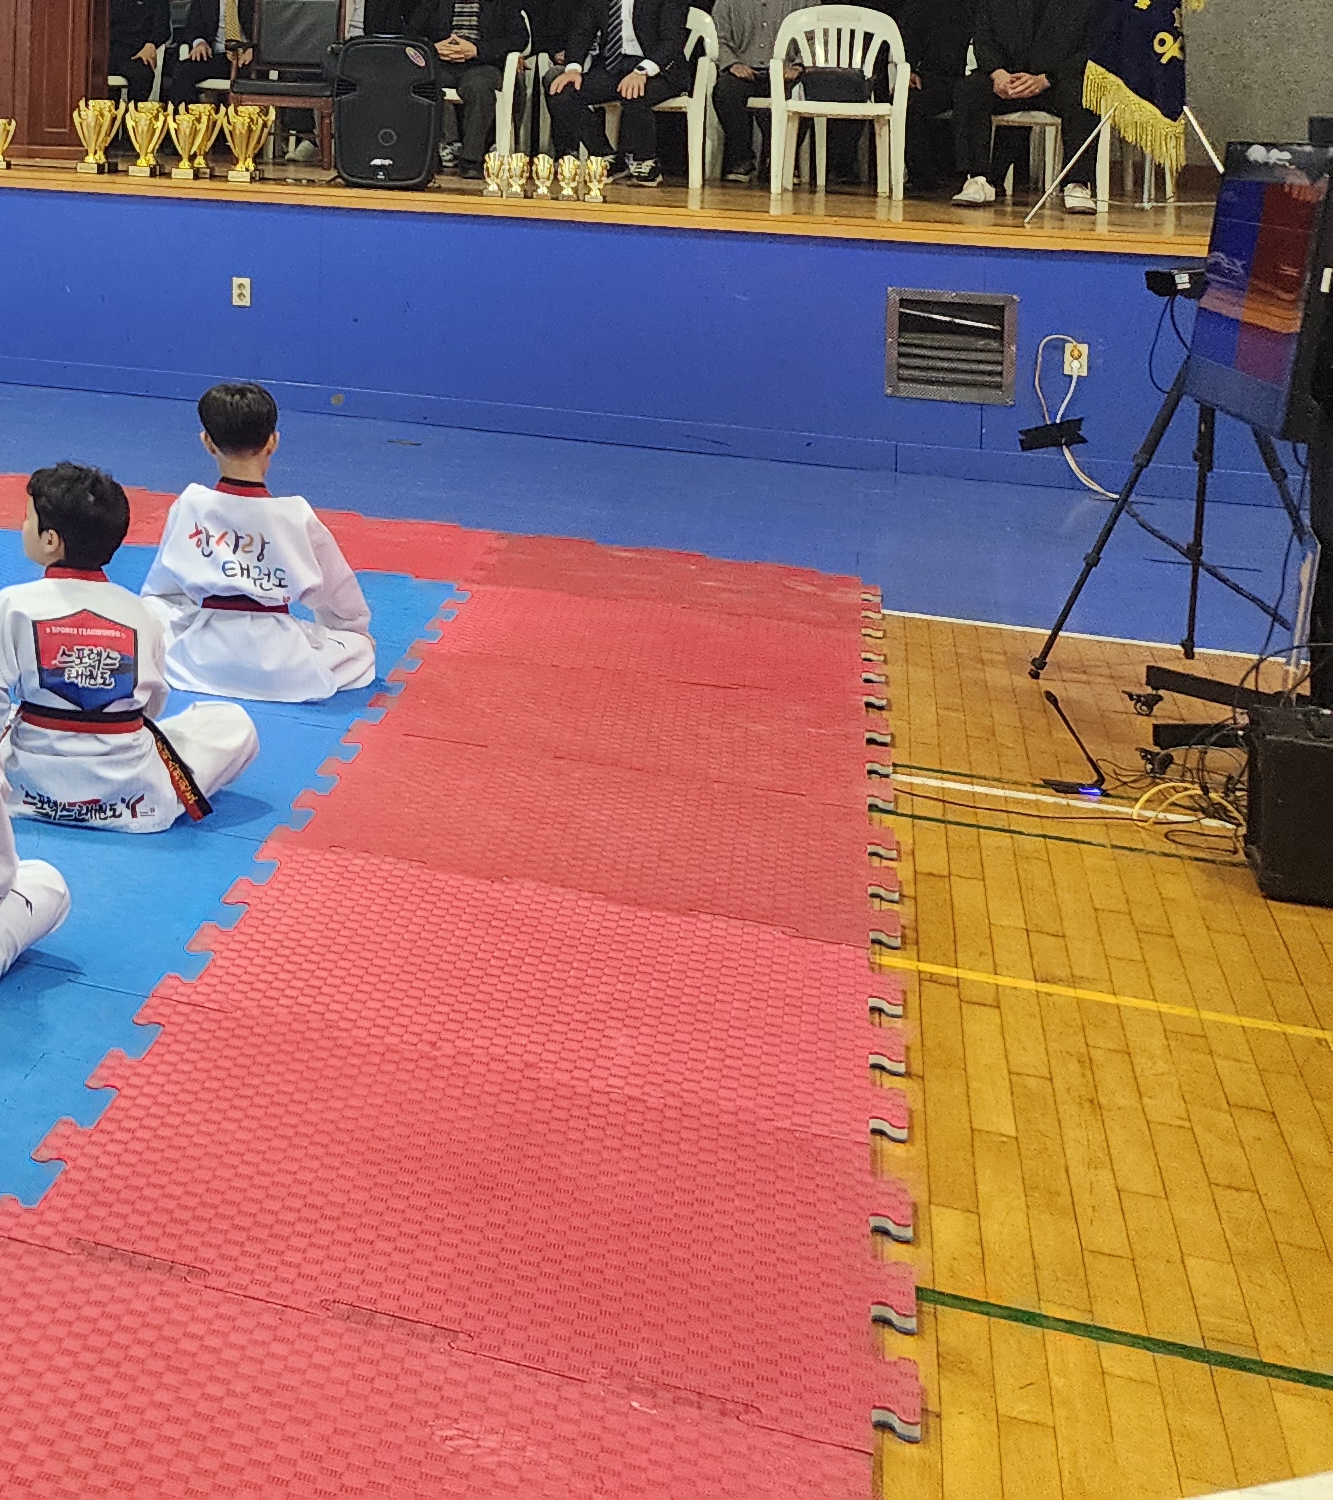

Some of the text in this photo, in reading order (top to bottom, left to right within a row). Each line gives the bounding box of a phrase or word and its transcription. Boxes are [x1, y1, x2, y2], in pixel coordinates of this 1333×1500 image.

[188, 520, 271, 562] 한사랑
[221, 559, 289, 591] 태권도
[57, 646, 120, 670] 스포렉스
[65, 667, 115, 689] 태권도
